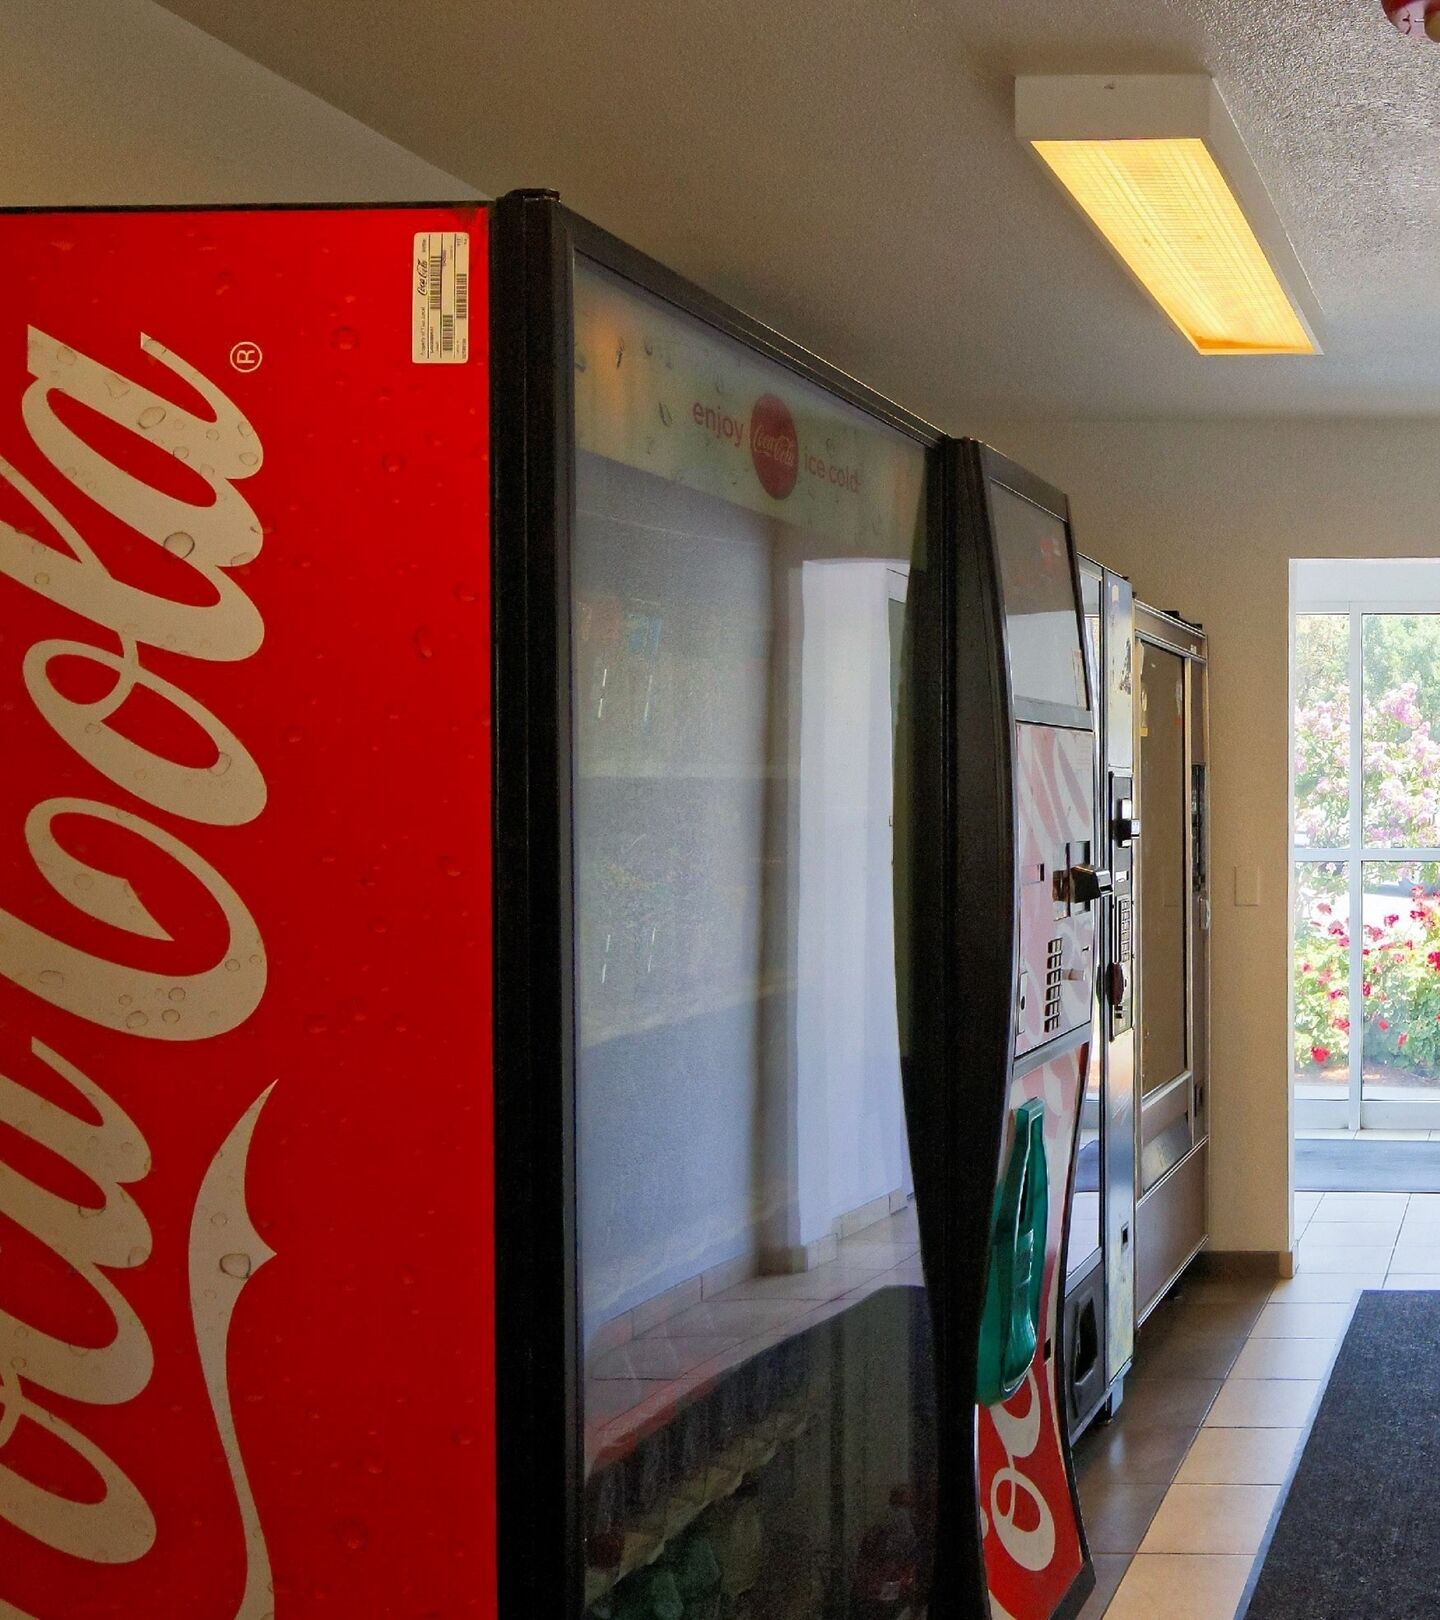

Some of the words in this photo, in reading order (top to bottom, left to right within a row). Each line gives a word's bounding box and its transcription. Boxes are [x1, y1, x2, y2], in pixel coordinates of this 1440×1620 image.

[692, 402, 744, 448] enjoy
[803, 449, 826, 478] ice
[0, 1037, 157, 1620] oca
